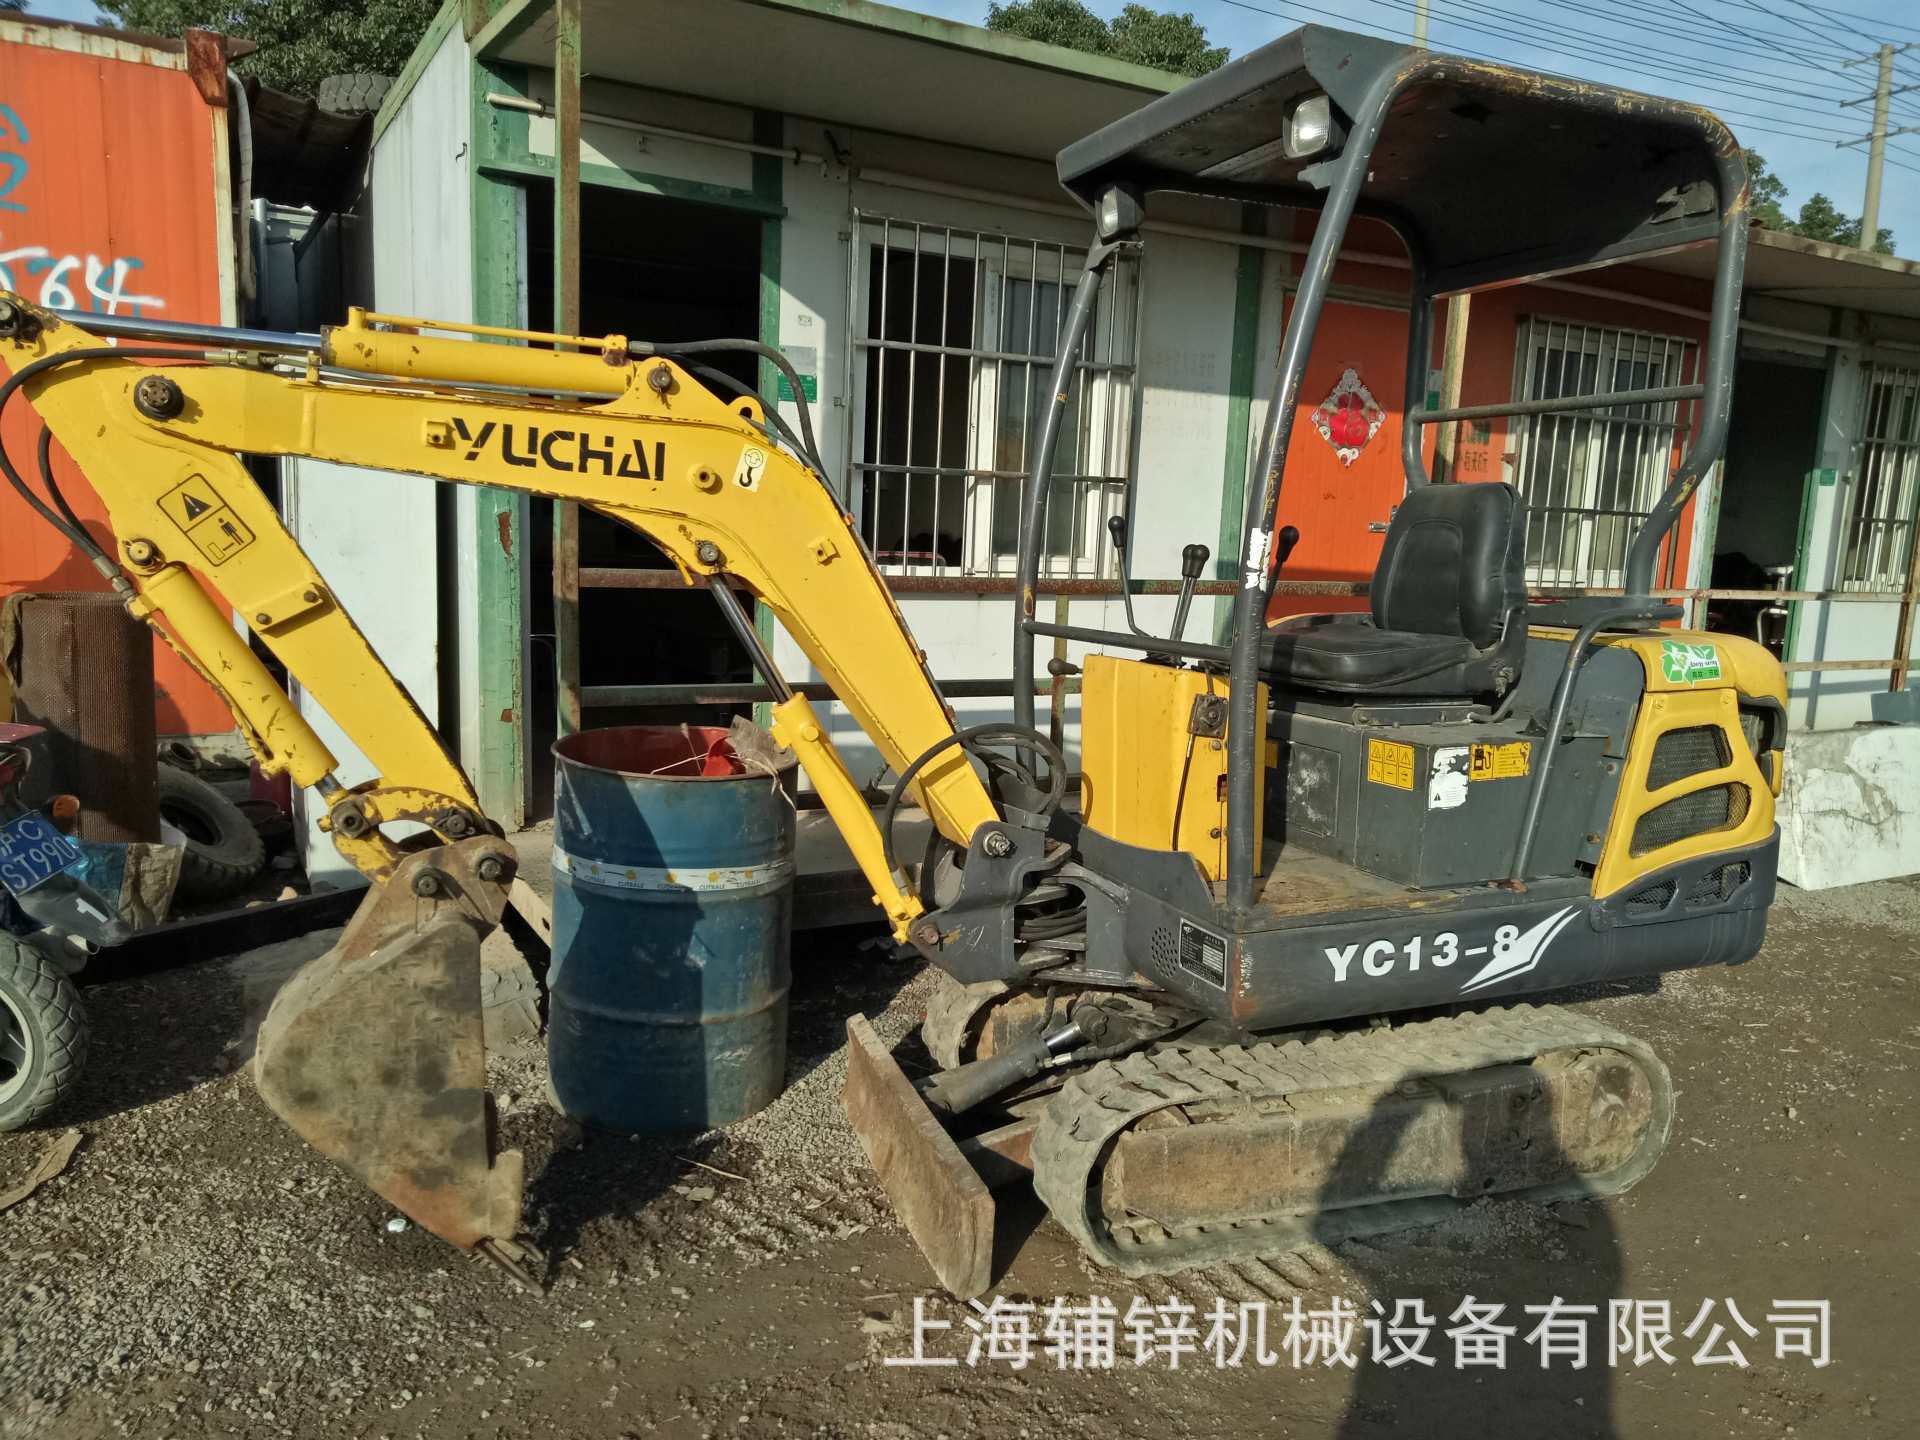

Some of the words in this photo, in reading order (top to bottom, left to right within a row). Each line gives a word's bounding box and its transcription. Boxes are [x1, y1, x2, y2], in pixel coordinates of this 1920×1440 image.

[451, 417, 666, 482] YUCHAI
[1, 836, 76, 890] ST990
[1324, 924, 1520, 983] YC13-8
